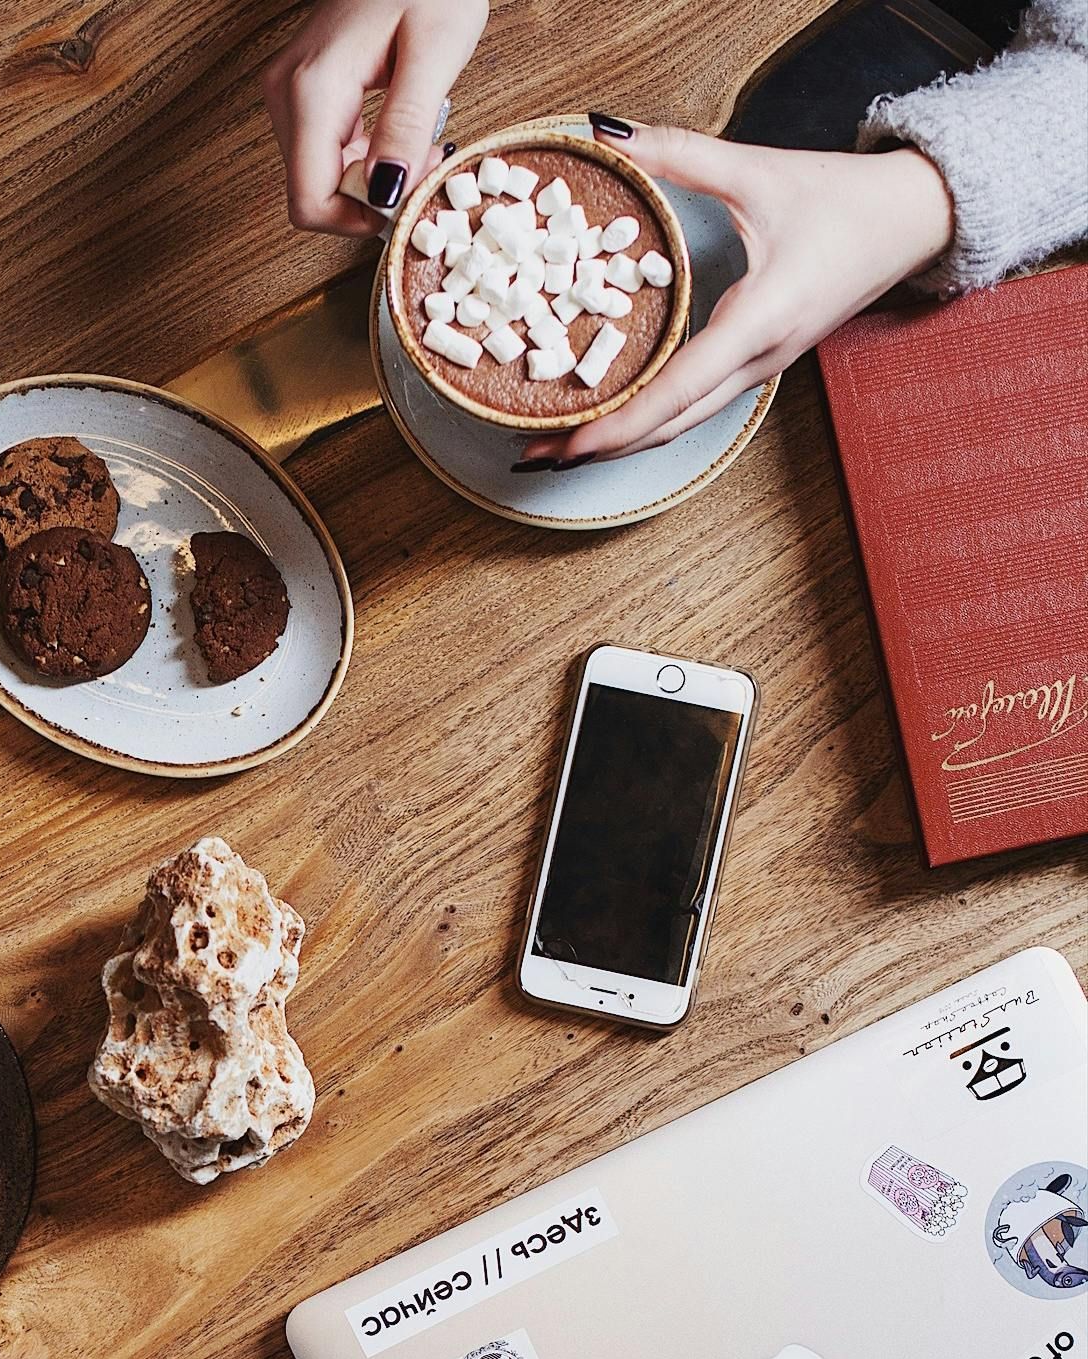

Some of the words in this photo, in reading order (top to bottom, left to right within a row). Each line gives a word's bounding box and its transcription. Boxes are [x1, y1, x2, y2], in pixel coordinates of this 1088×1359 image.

[998, 989, 1040, 1012] Bus
[902, 1012, 990, 1056] Station
[511, 1206, 602, 1260] здесь
[482, 1248, 504, 1286] //
[361, 1271, 473, 1336] сейчас
